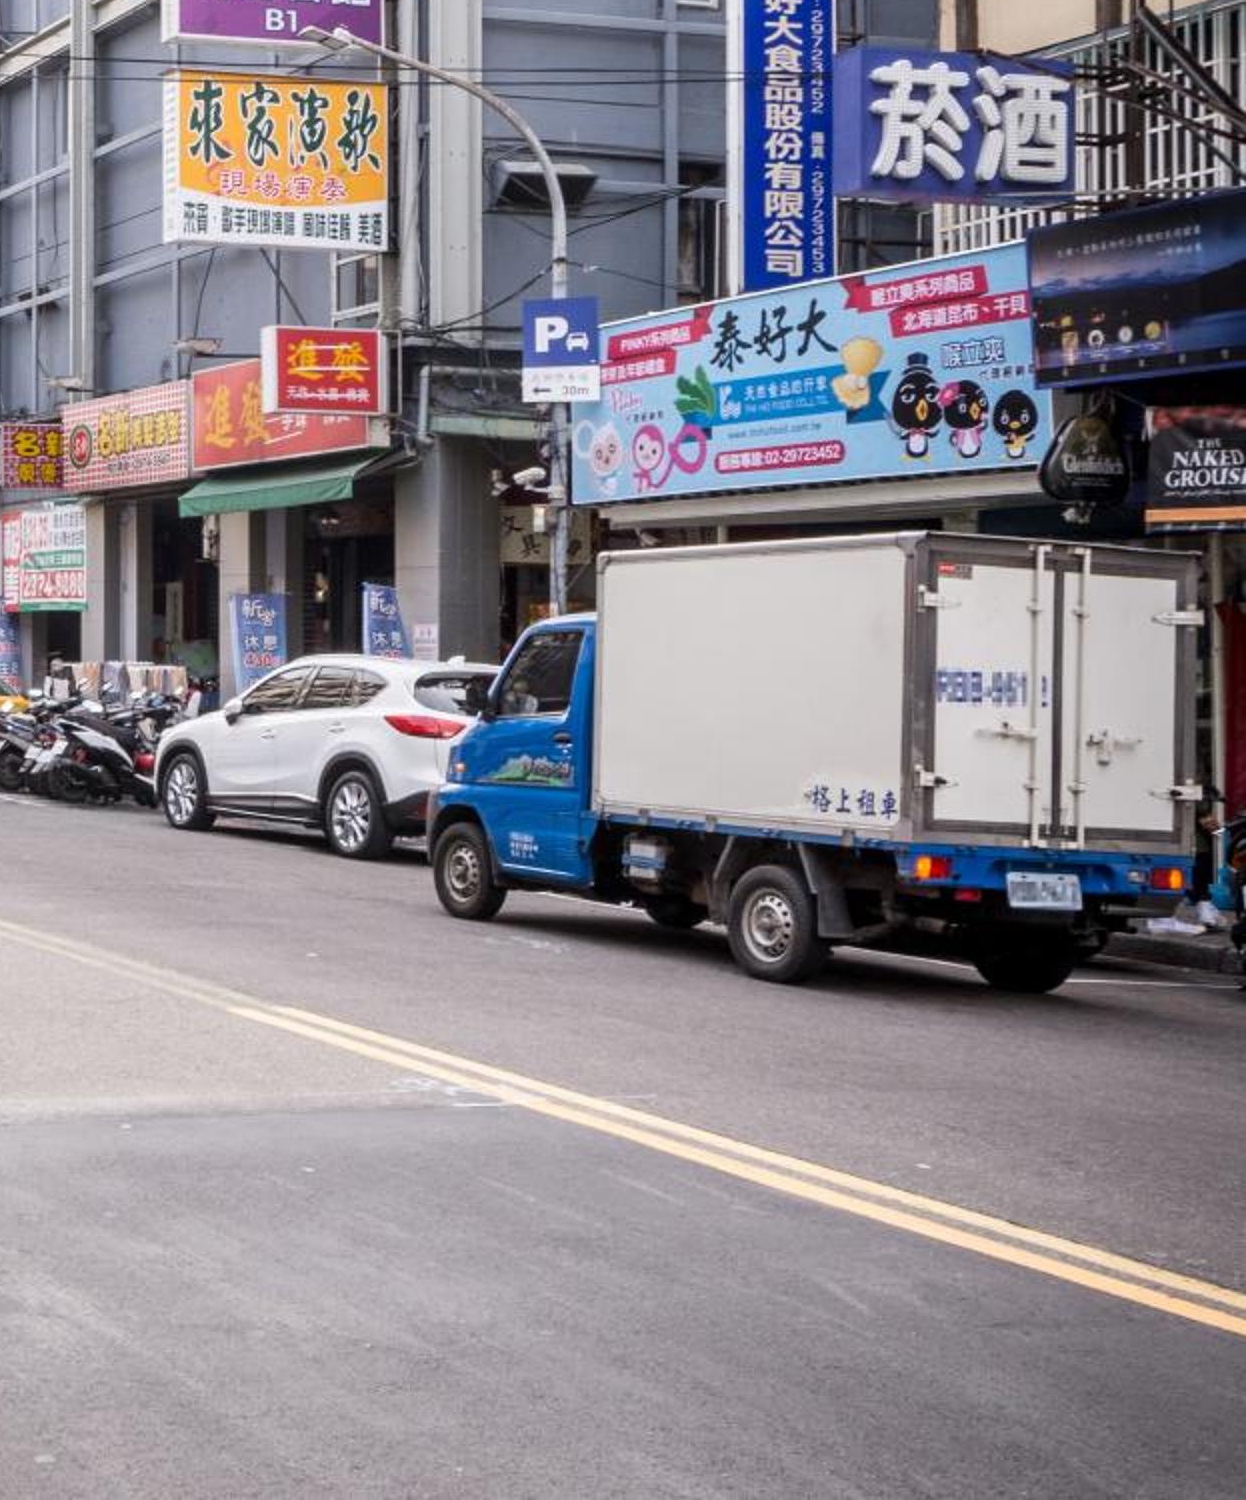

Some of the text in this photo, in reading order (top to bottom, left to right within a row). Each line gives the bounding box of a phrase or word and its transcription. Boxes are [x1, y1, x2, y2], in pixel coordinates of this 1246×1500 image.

[265, 8, 299, 32] B1
[869, 59, 1071, 183] 菸酒
[535, 317, 569, 353] P
[710, 298, 838, 372] 泰好大
[1172, 449, 1244, 468] NAKED
